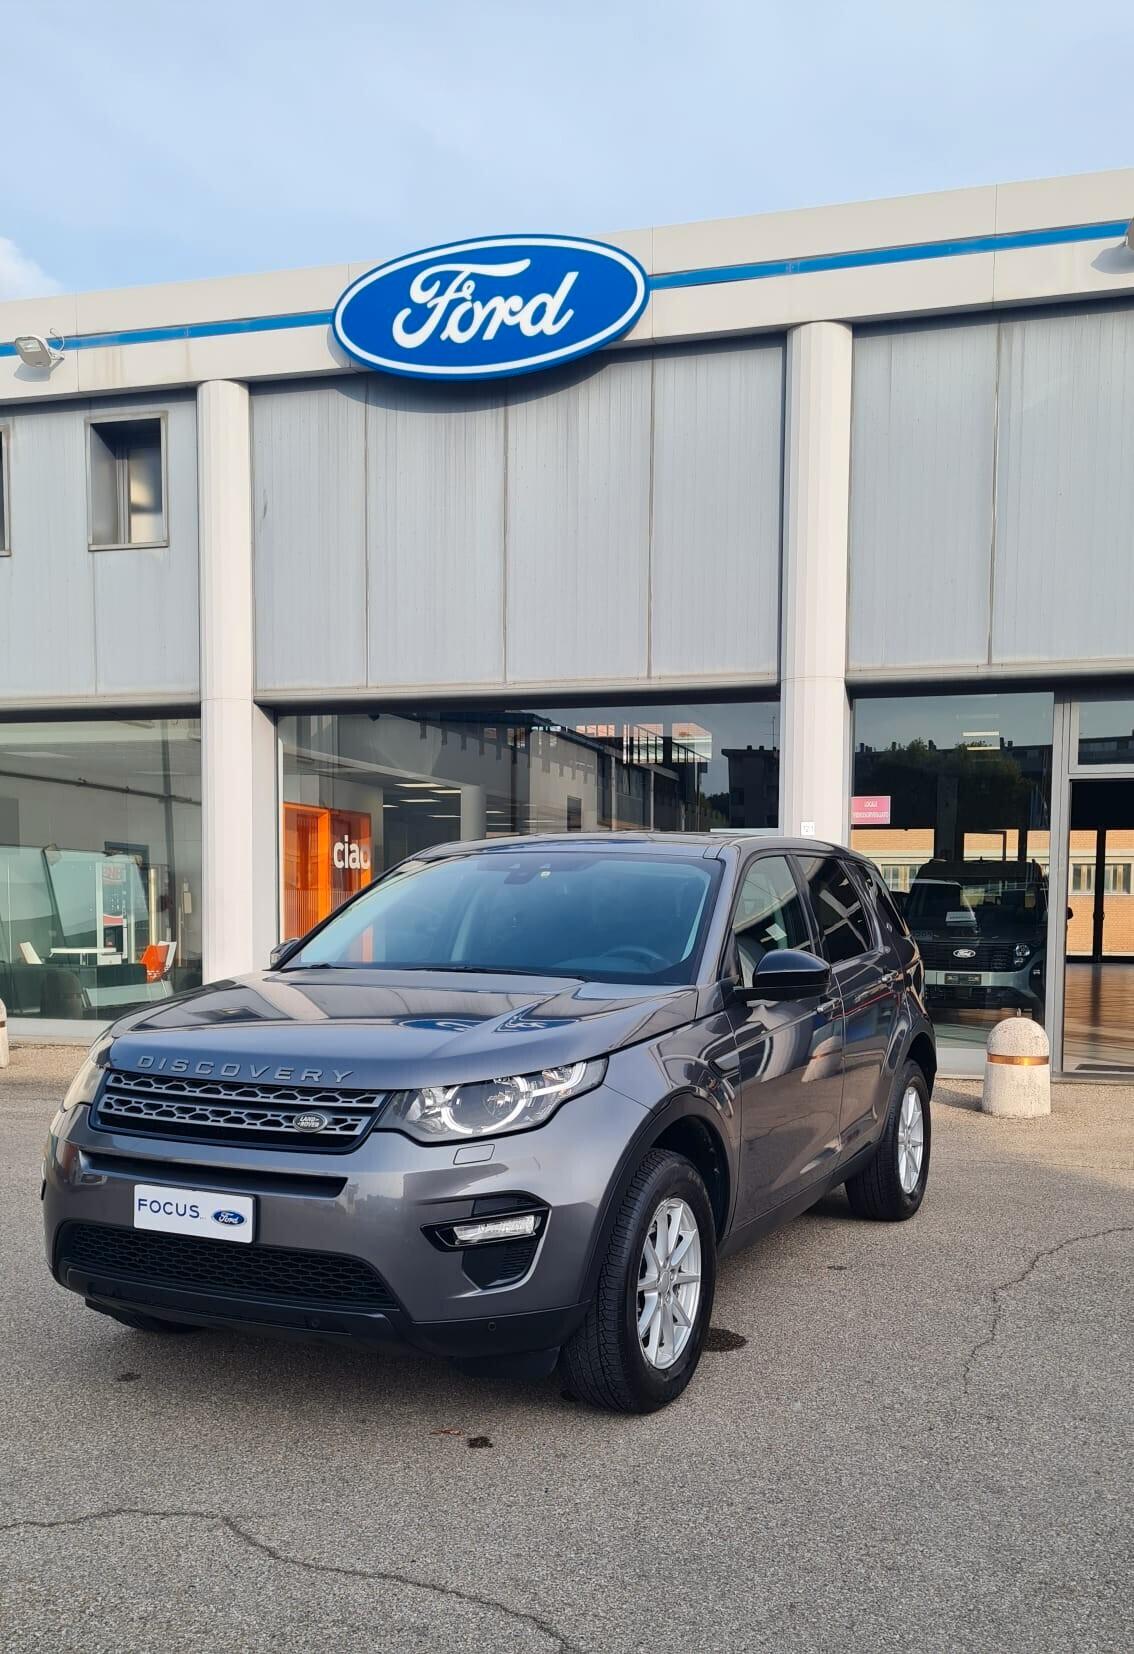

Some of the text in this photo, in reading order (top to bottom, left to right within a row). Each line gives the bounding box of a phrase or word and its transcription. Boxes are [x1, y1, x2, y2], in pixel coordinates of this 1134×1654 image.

[392, 258, 579, 349] Ford
[137, 1055, 354, 1084] DISCOVERY
[137, 1198, 201, 1219] FOCUS
[218, 1211, 240, 1225] Ford
